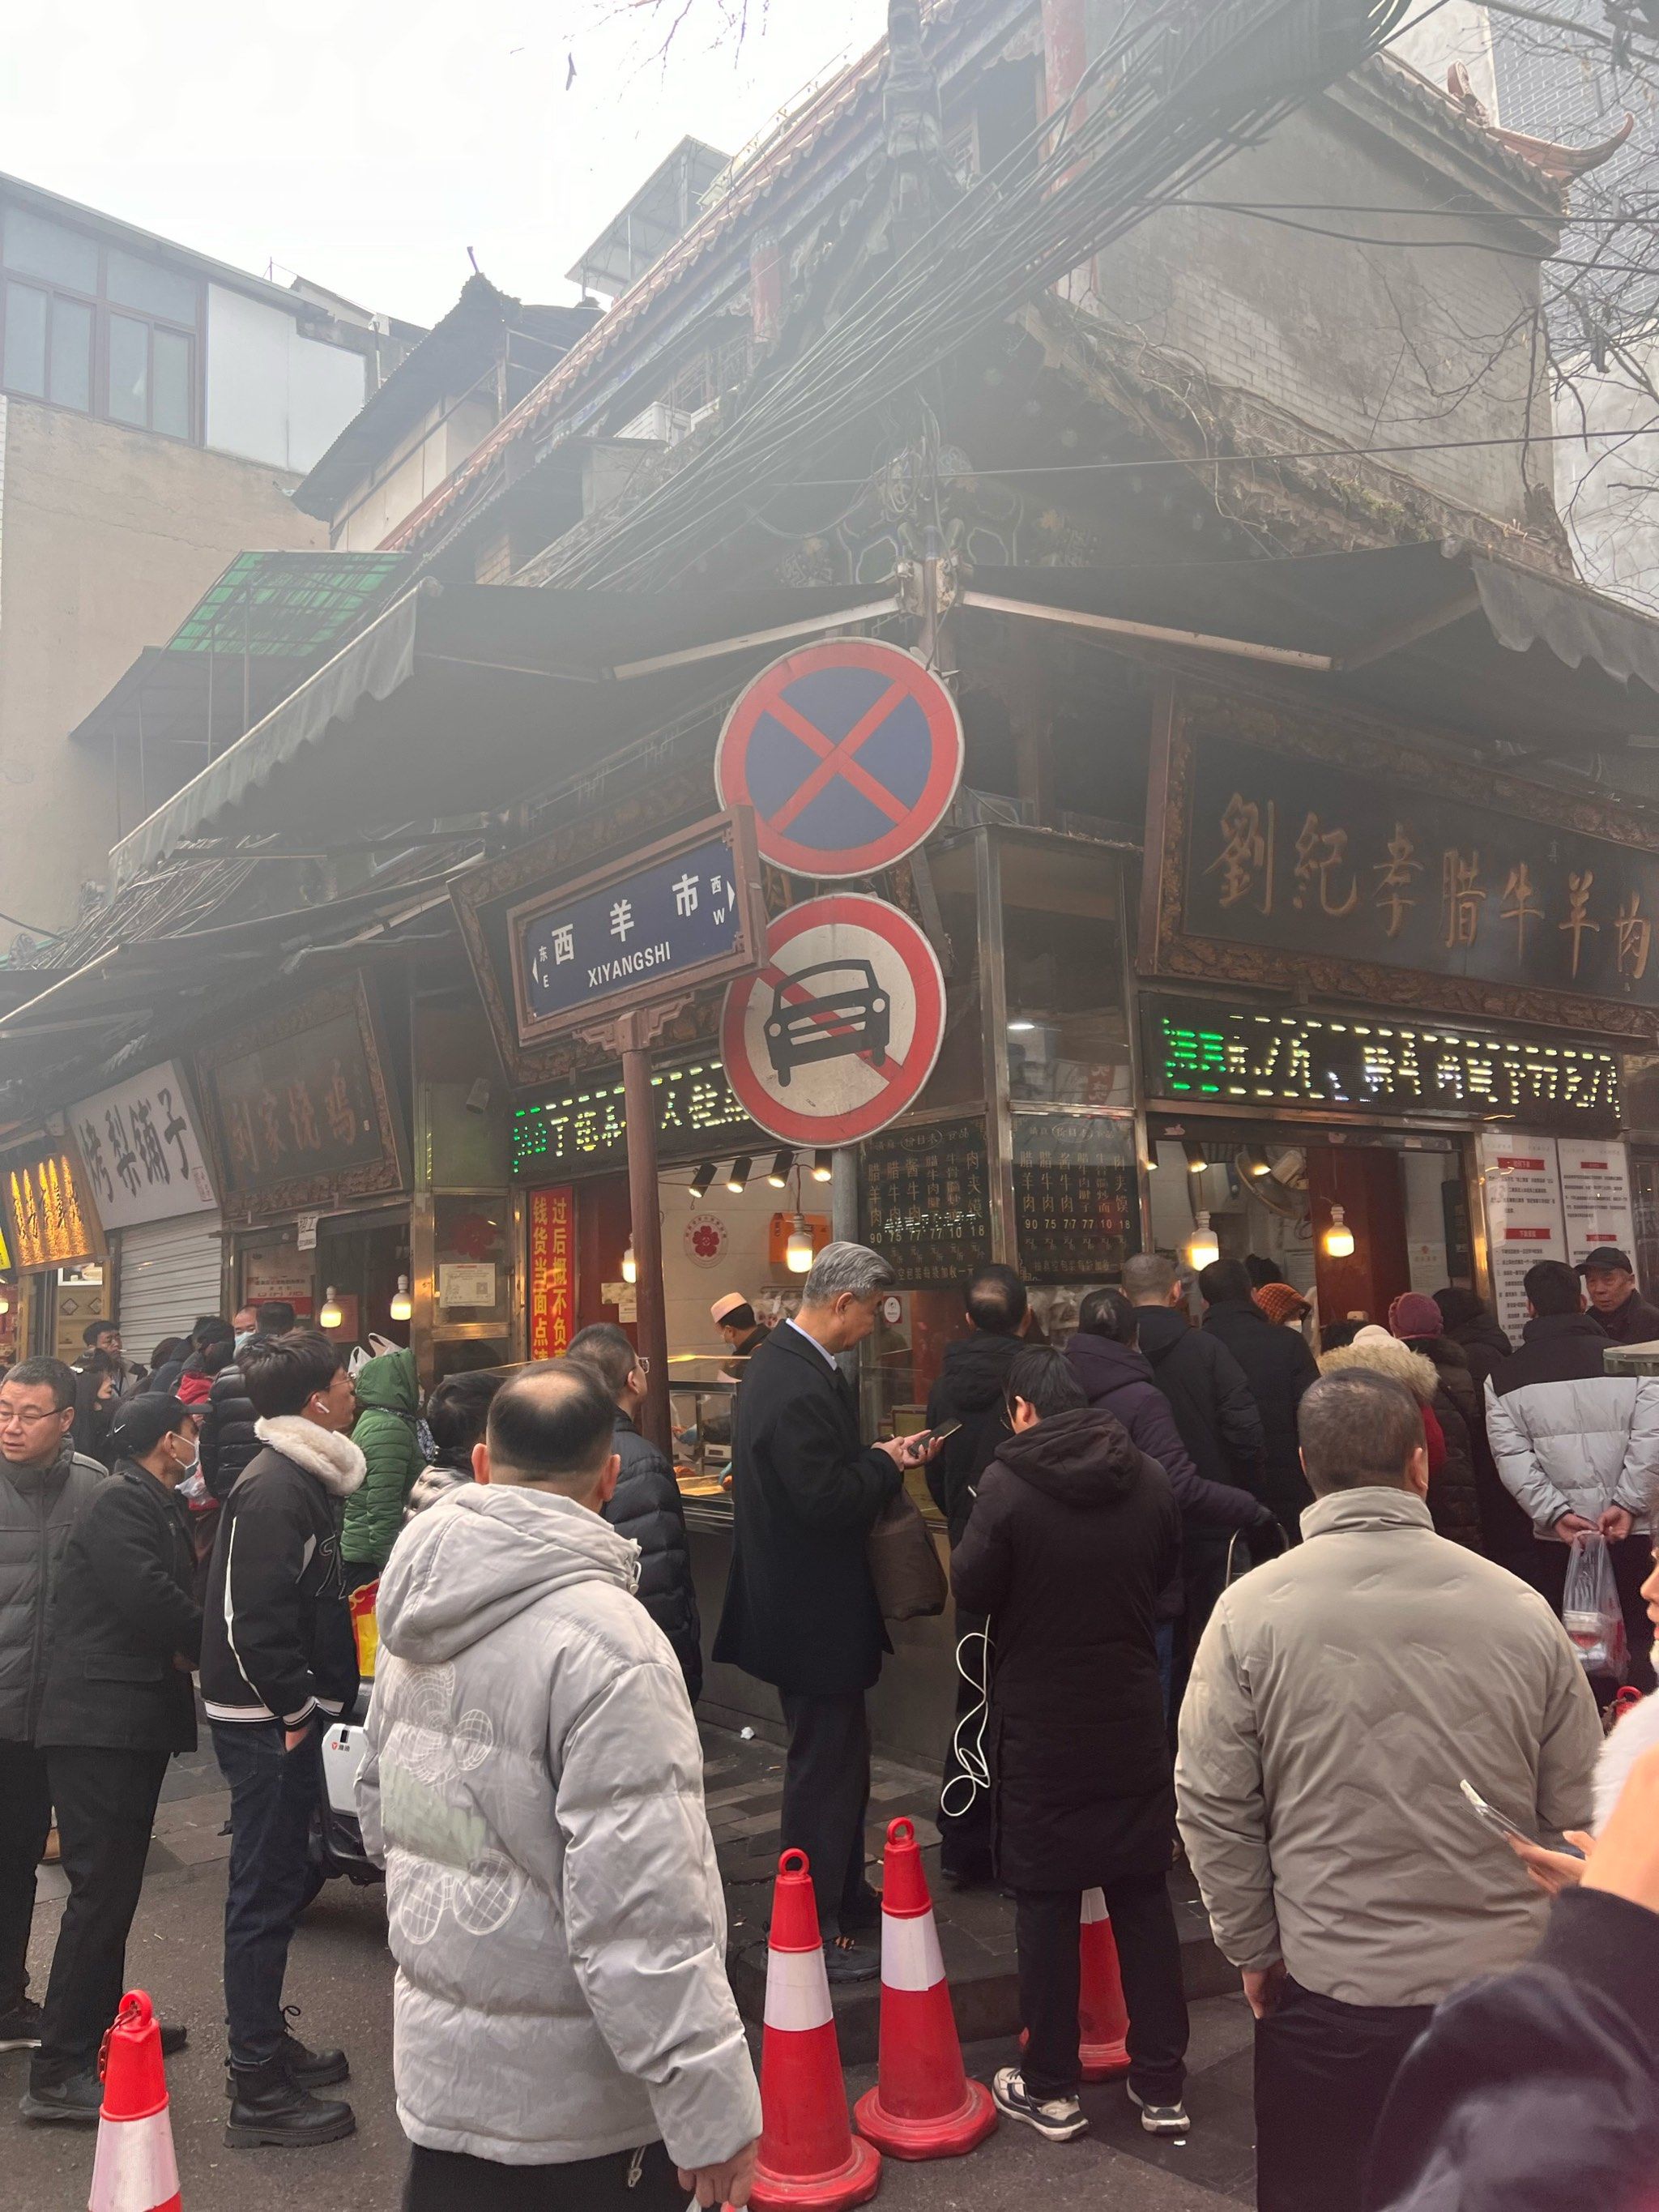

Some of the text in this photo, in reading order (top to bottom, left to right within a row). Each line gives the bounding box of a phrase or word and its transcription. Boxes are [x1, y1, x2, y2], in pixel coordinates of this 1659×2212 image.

[710, 876, 722, 895] 西
[552, 873, 700, 966] 西羊市
[713, 908, 725, 926] W
[539, 945, 548, 963] 东
[587, 941, 672, 989] XIYANGSHI
[543, 974, 550, 989] E
[1020, 1151, 1036, 1212] 腊羊肉
[1039, 1151, 1055, 1212] 腊牛肉
[868, 1163, 881, 1227] 腊羊肉
[1025, 1219, 1038, 1229] 90
[1044, 1219, 1057, 1229] 75
[1063, 1219, 1077, 1229] 77
[1082, 1219, 1094, 1229] 77
[1100, 1219, 1112, 1229] 10
[1120, 1219, 1131, 1229] 18
[890, 1231, 902, 1242] 75
[910, 1230, 921, 1241] 77
[931, 1228, 942, 1240] 77
[949, 1227, 962, 1238] 10
[971, 1225, 985, 1236] 18
[870, 1232, 881, 1244] 90
